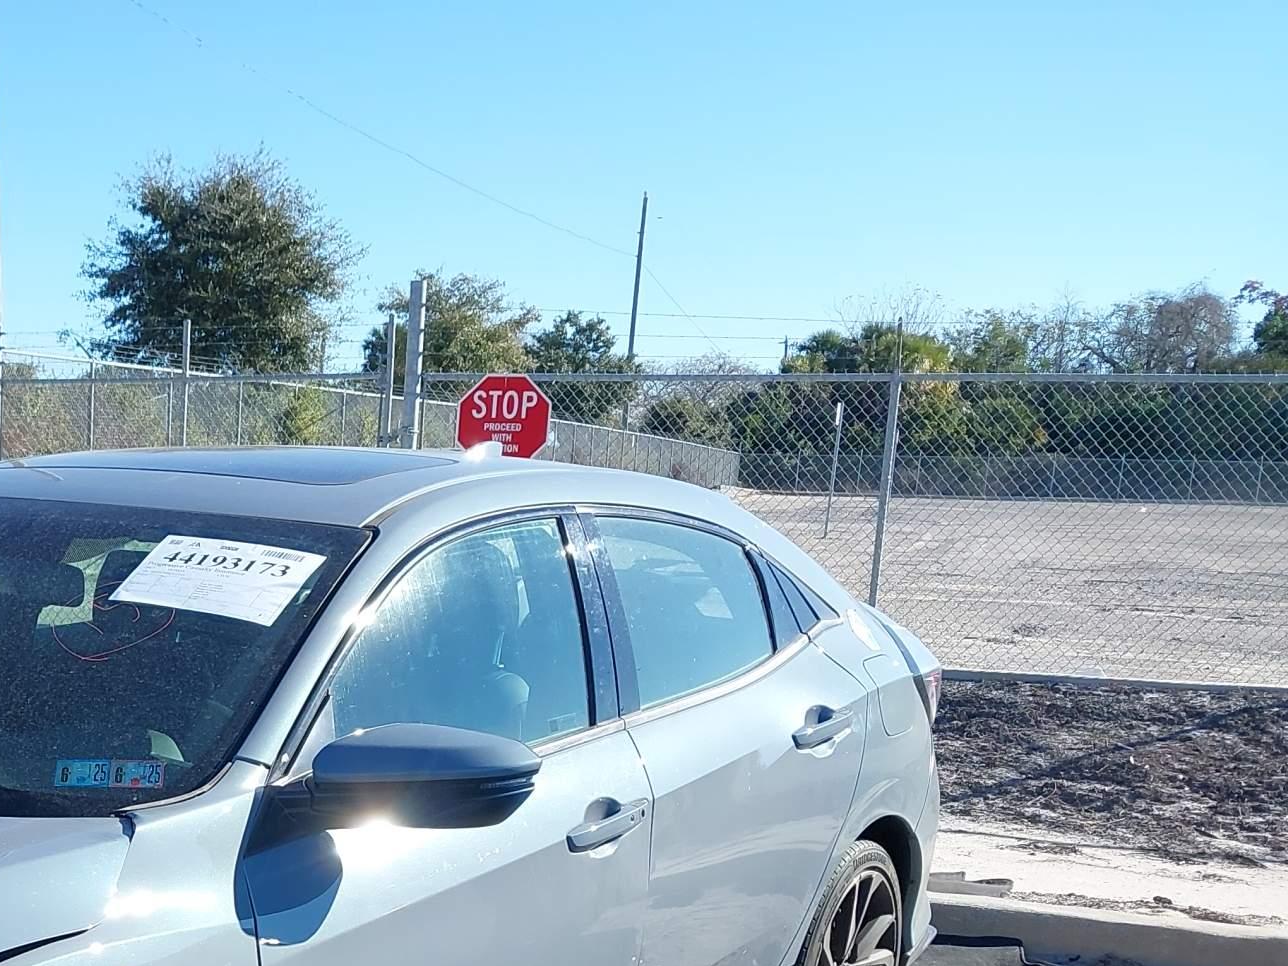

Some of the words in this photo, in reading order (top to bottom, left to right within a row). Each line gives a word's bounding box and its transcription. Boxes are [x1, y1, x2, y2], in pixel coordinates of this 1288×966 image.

[472, 390, 538, 419] STOP
[484, 423, 522, 431] PROCEED
[491, 433, 512, 442] WITH
[163, 551, 291, 577] 44193173
[60, 767, 70, 783] 6
[93, 763, 109, 782] 25
[115, 767, 123, 783] 6
[147, 764, 162, 784] 25
